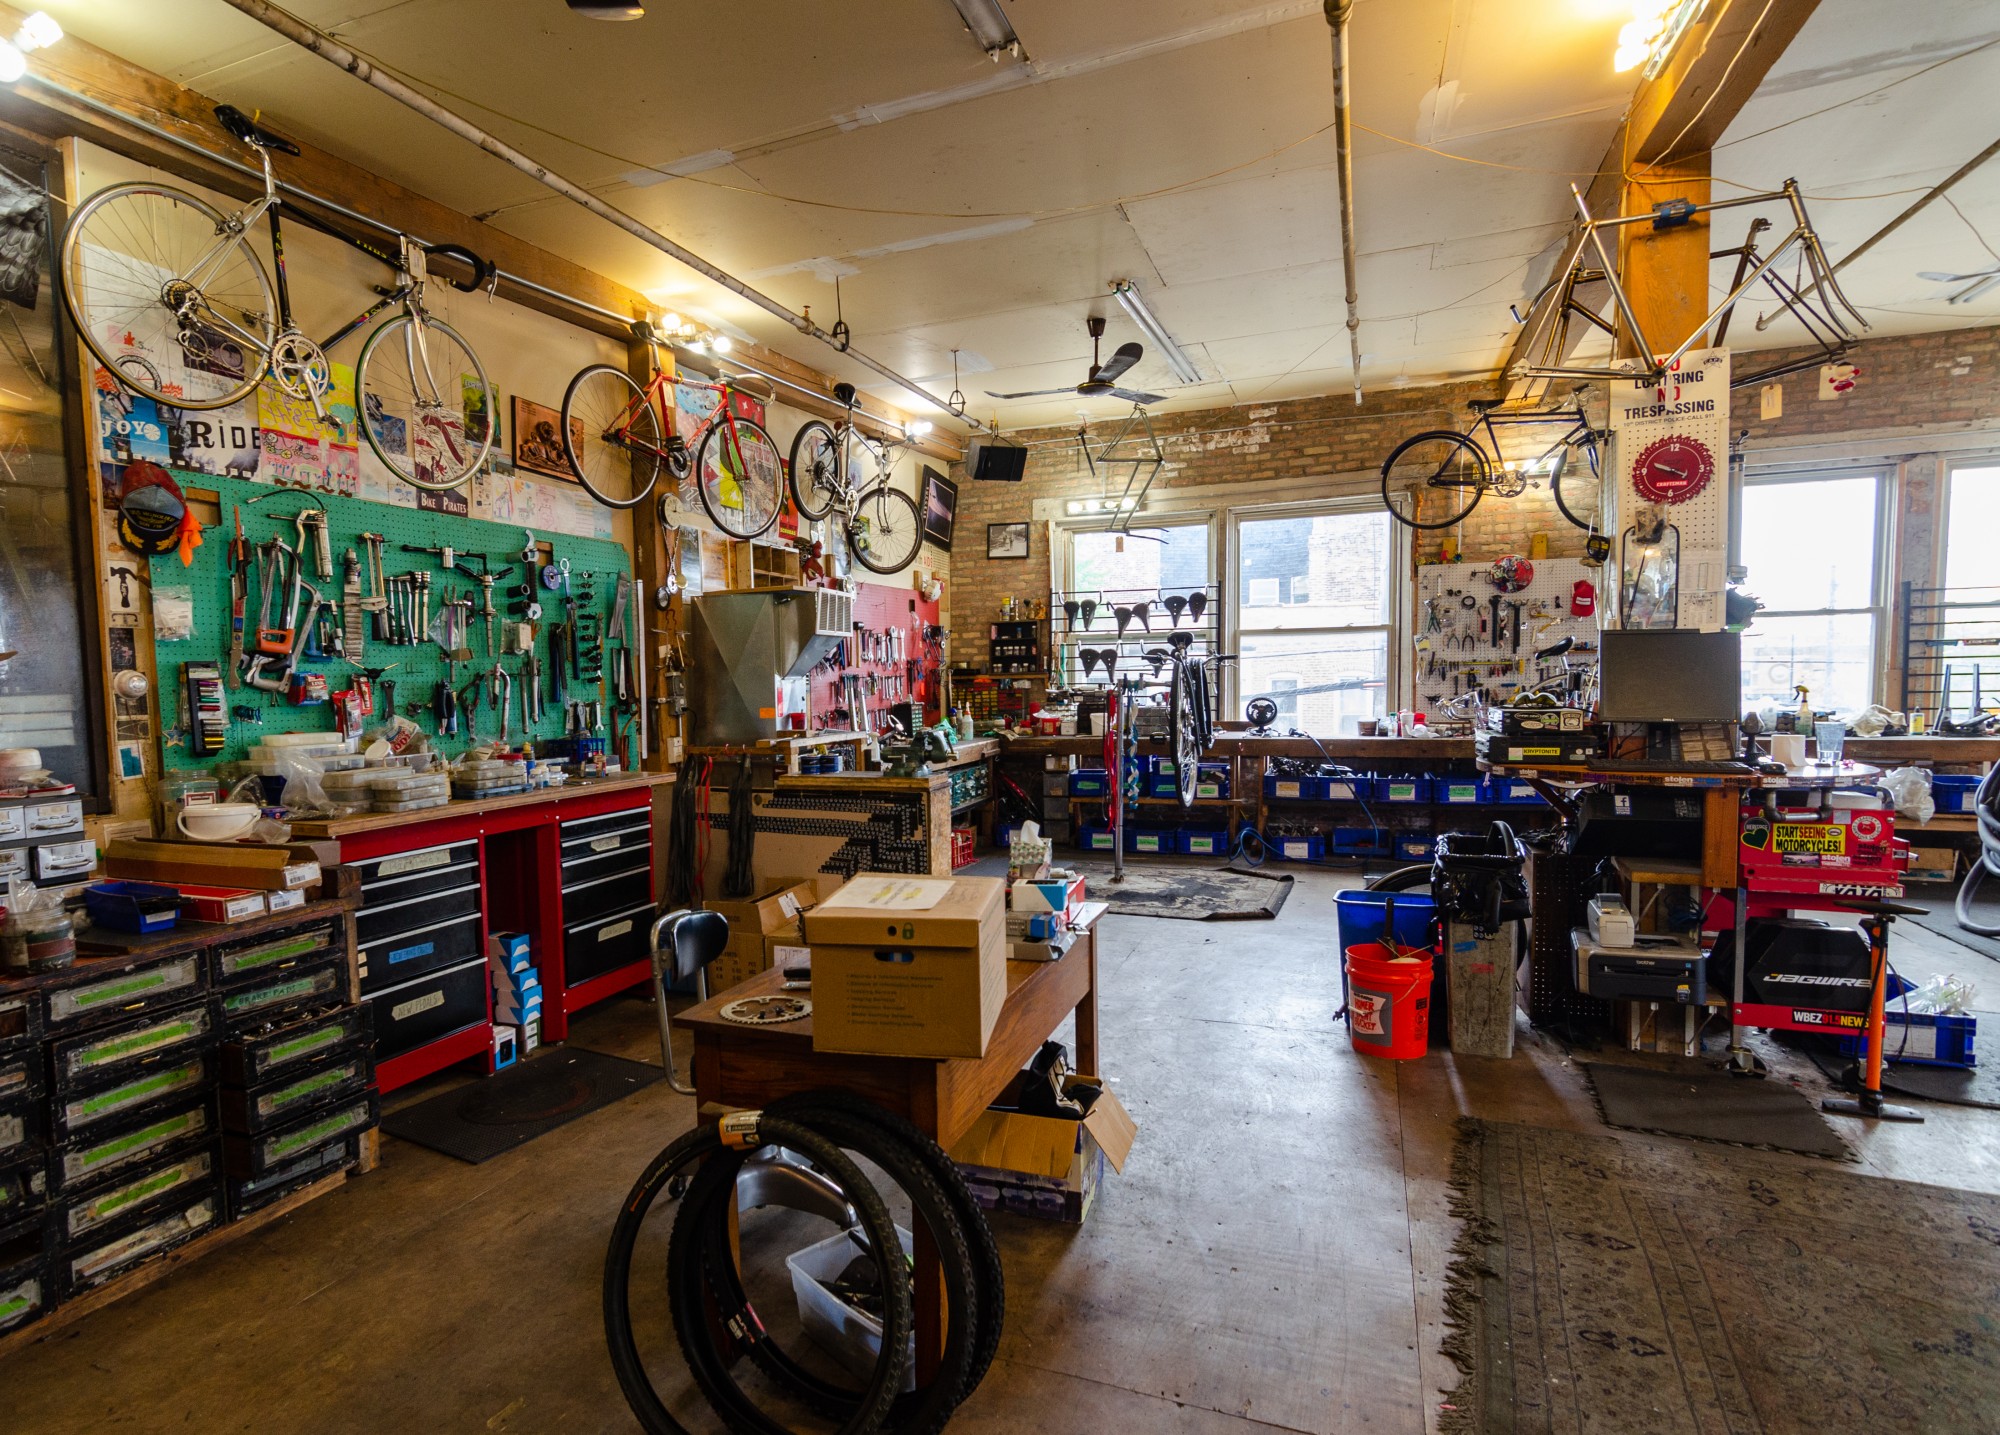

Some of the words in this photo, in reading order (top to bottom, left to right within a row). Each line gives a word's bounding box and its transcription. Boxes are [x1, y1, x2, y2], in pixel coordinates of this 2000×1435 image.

[101, 420, 144, 437] JOY
[1670, 444, 1680, 452] 12
[1641, 467, 1647, 475] 9
[1667, 489, 1673, 497] 6
[421, 492, 436, 508] BIKE
[443, 497, 467, 513] PIRATES
[1664, 776, 1693, 785] stolen
[1724, 777, 1751, 786] stolen
[1763, 777, 1788, 785] stolen
[1776, 826, 1799, 838] START
[1799, 827, 1826, 839] SEEING
[1776, 839, 1842, 852] MOTORCYCLES!
[1822, 854, 1850, 865] stolen
[239, 991, 269, 1005] BRAKE
[398, 1002, 412, 1017] NEW
[1793, 1011, 1822, 1024] WBEZ
